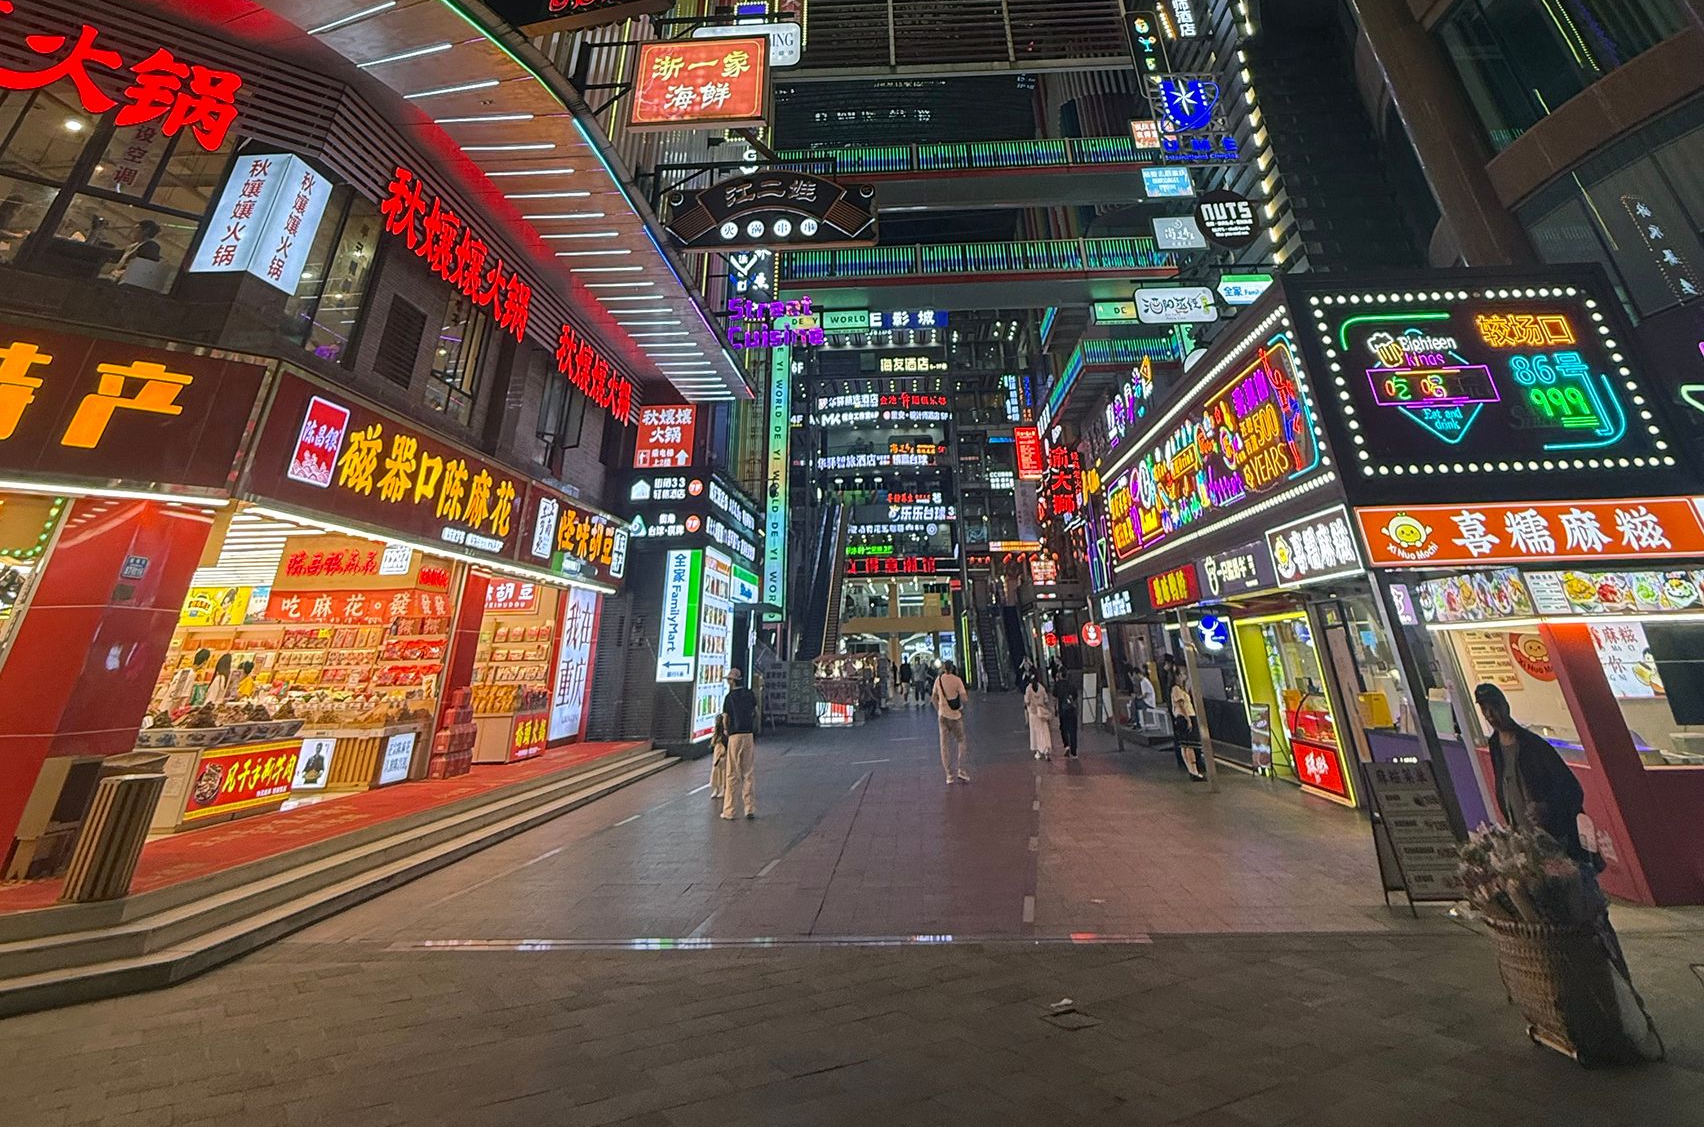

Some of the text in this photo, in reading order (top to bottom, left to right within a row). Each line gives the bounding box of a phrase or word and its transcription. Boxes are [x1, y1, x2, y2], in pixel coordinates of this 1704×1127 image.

[0, 0, 243, 151] 火锅
[664, 81, 732, 110] 海鲜
[1200, 201, 1253, 221] NUTS
[1223, 286, 1244, 297] 全家
[728, 295, 813, 321] Street
[831, 315, 866, 324] WORLD
[727, 323, 825, 350] Cuisine
[1475, 314, 1576, 347] 较场口
[1398, 335, 1457, 353] Eighteen
[791, 362, 804, 374] 6F
[880, 357, 929, 372] 海友酒店
[775, 379, 784, 419] WORLD
[1253, 403, 1280, 447] 500
[1434, 417, 1462, 431] drink
[1444, 407, 1463, 419] and
[649, 426, 682, 443] 火锅
[1249, 442, 1289, 486] YEARS
[338, 423, 516, 537] 磁器口陈麻花
[901, 506, 946, 521] 乐乐台球
[558, 509, 615, 566] 怪味胡豆
[1451, 505, 1673, 558] 喜糯麻糍
[1397, 547, 1416, 561] Nuo
[1416, 541, 1439, 560] Mochi
[667, 553, 687, 652] 全家 FamilyMart
[565, 600, 593, 651] 我在
